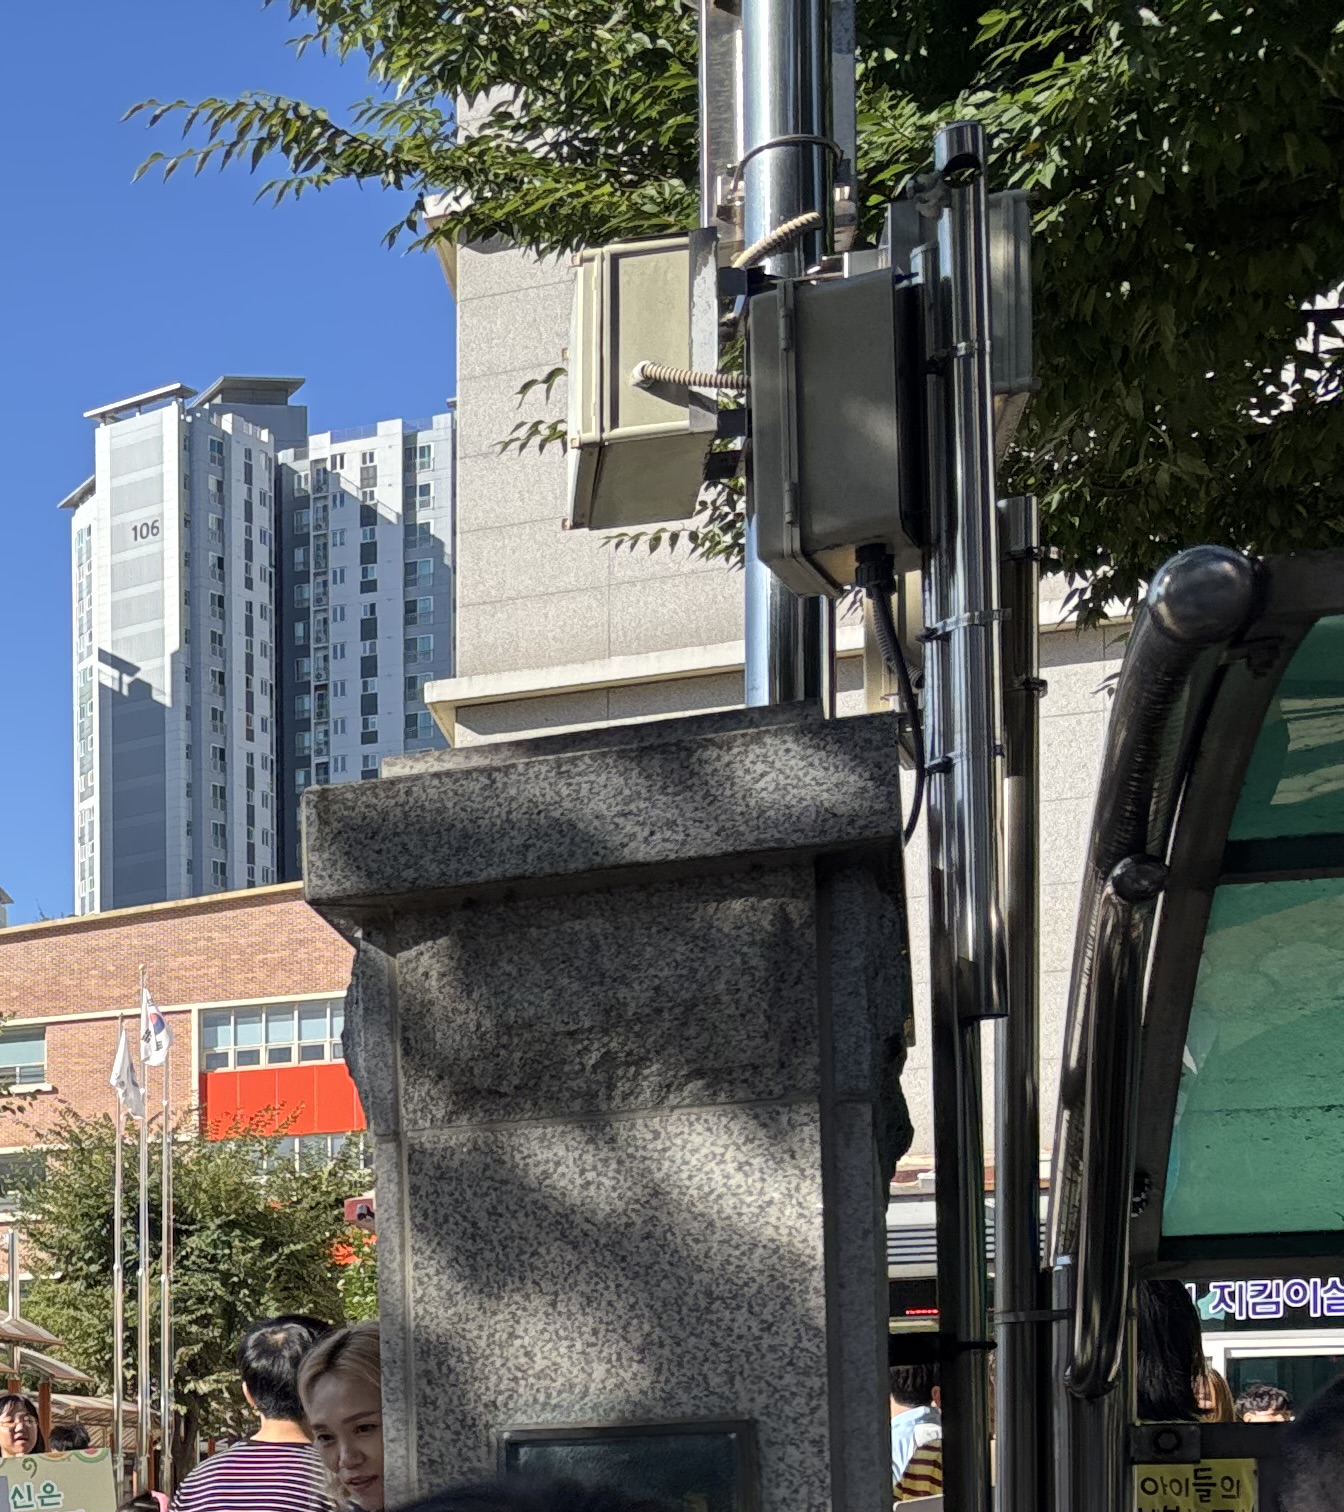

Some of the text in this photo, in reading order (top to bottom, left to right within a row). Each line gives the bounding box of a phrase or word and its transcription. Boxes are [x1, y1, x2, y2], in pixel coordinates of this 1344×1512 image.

[132, 519, 160, 542] 106
[11, 1482, 62, 1509] 신은
[1140, 1467, 1241, 1503] 아이들의
